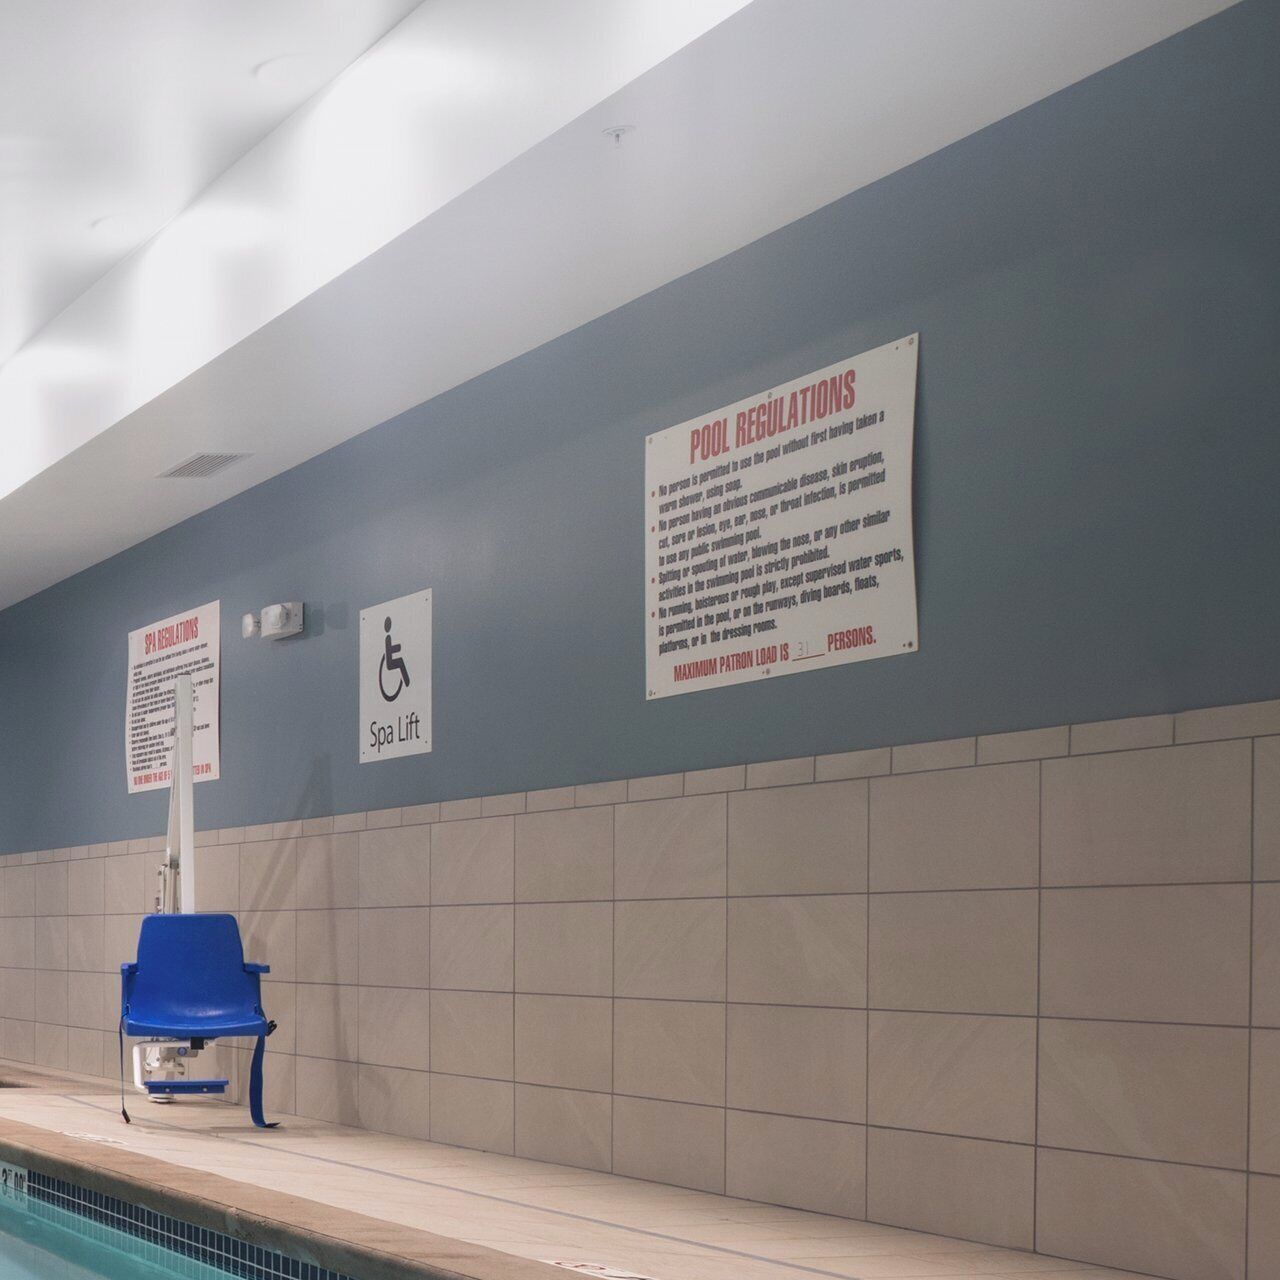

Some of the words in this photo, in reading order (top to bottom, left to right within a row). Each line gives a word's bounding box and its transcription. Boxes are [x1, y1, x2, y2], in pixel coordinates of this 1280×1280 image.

[690, 416, 729, 465] POOL
[735, 368, 855, 449] REGULATIONS
[145, 633, 156, 655] SPA
[157, 617, 199, 651] REGULATIONS
[673, 657, 717, 682] MAXIMUM
[719, 649, 753, 673] PATRON
[755, 644, 777, 666] LOAD
[779, 642, 789, 662] IS
[827, 624, 876, 652] PERSONS.
[370, 722, 393, 752] Spa
[398, 713, 420, 743] Lift
